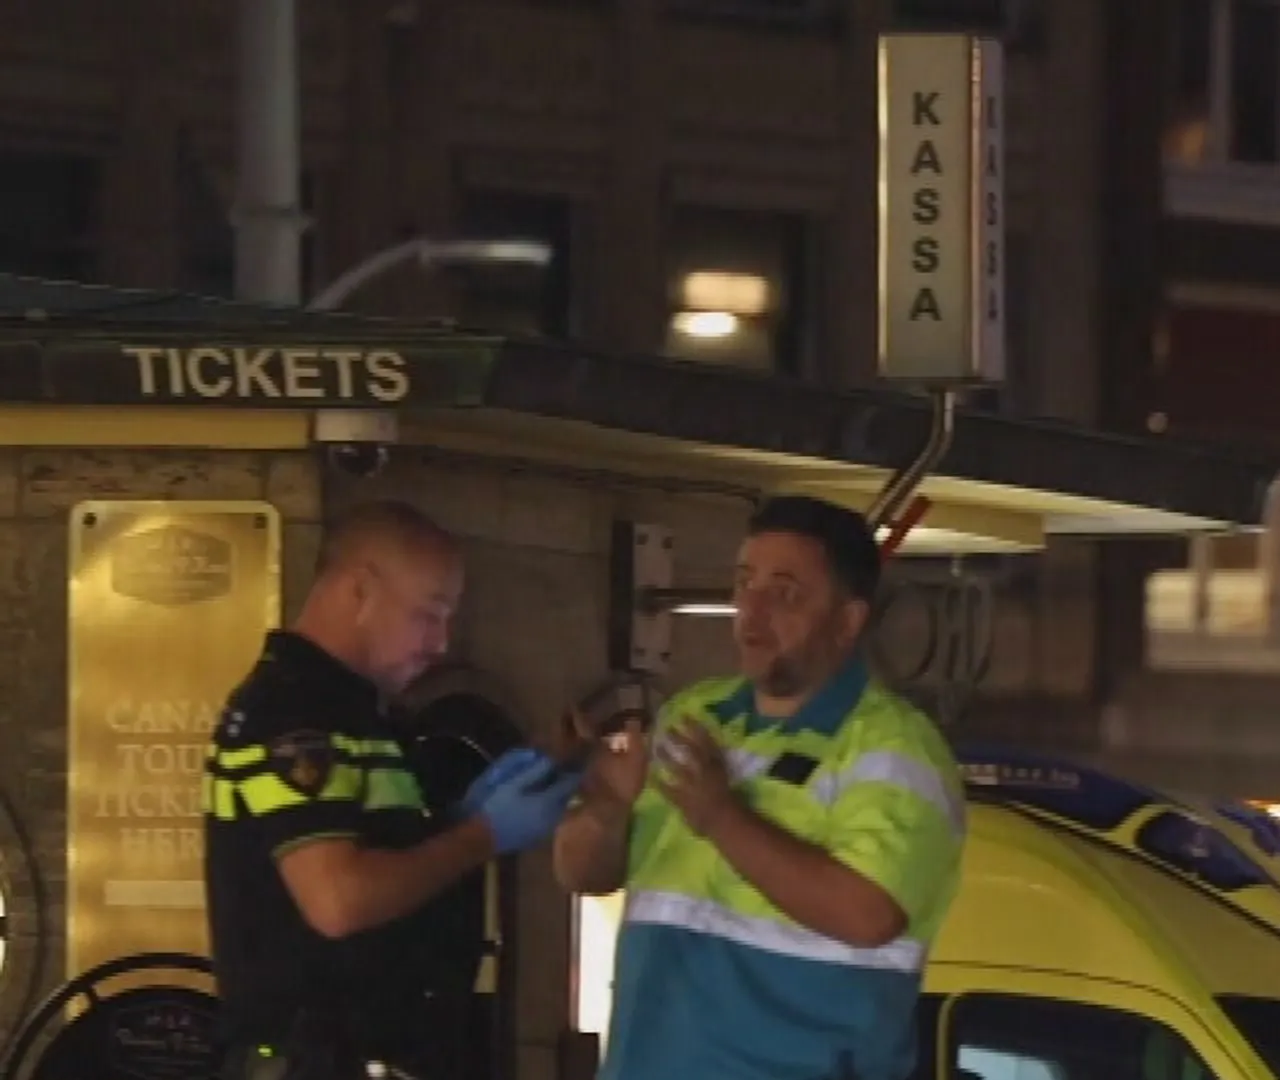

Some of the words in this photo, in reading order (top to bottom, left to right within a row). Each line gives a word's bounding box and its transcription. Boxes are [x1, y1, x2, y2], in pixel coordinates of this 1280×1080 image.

[909, 90, 943, 322] KASSA
[122, 344, 410, 401] TICKETS
[105, 701, 218, 733] CANA
[116, 743, 203, 776] TOU
[95, 785, 205, 818] TICK
[120, 826, 202, 860] HER
